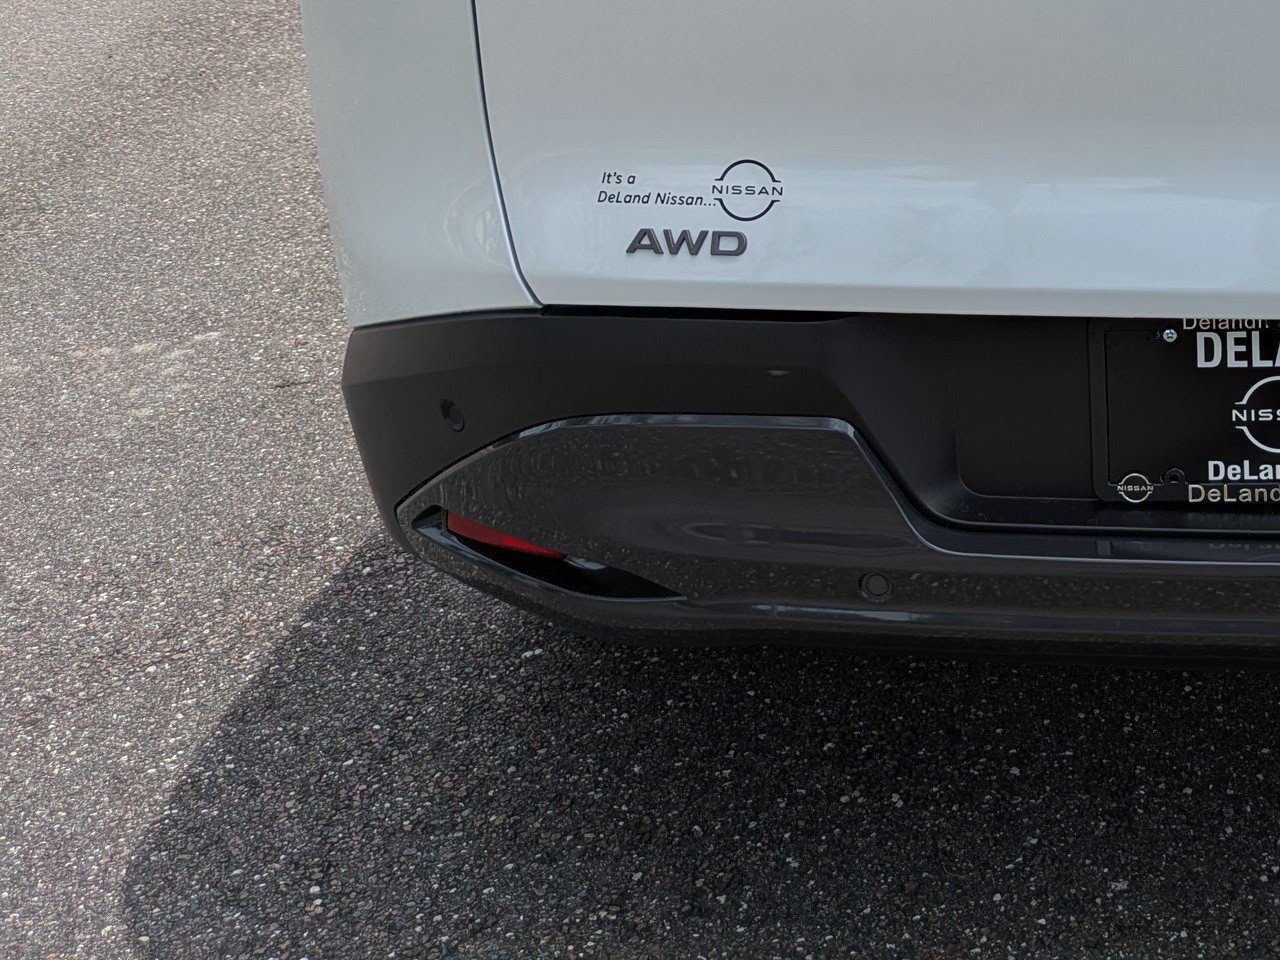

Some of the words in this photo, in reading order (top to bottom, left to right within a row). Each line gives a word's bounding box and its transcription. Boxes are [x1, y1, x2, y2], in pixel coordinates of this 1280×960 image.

[601, 171, 622, 185] It's
[627, 175, 636, 185] a
[711, 185, 783, 196] NISSAN
[598, 191, 650, 205] DeLand
[655, 192, 716, 207] Nissan...
[626, 228, 748, 257] AWD
